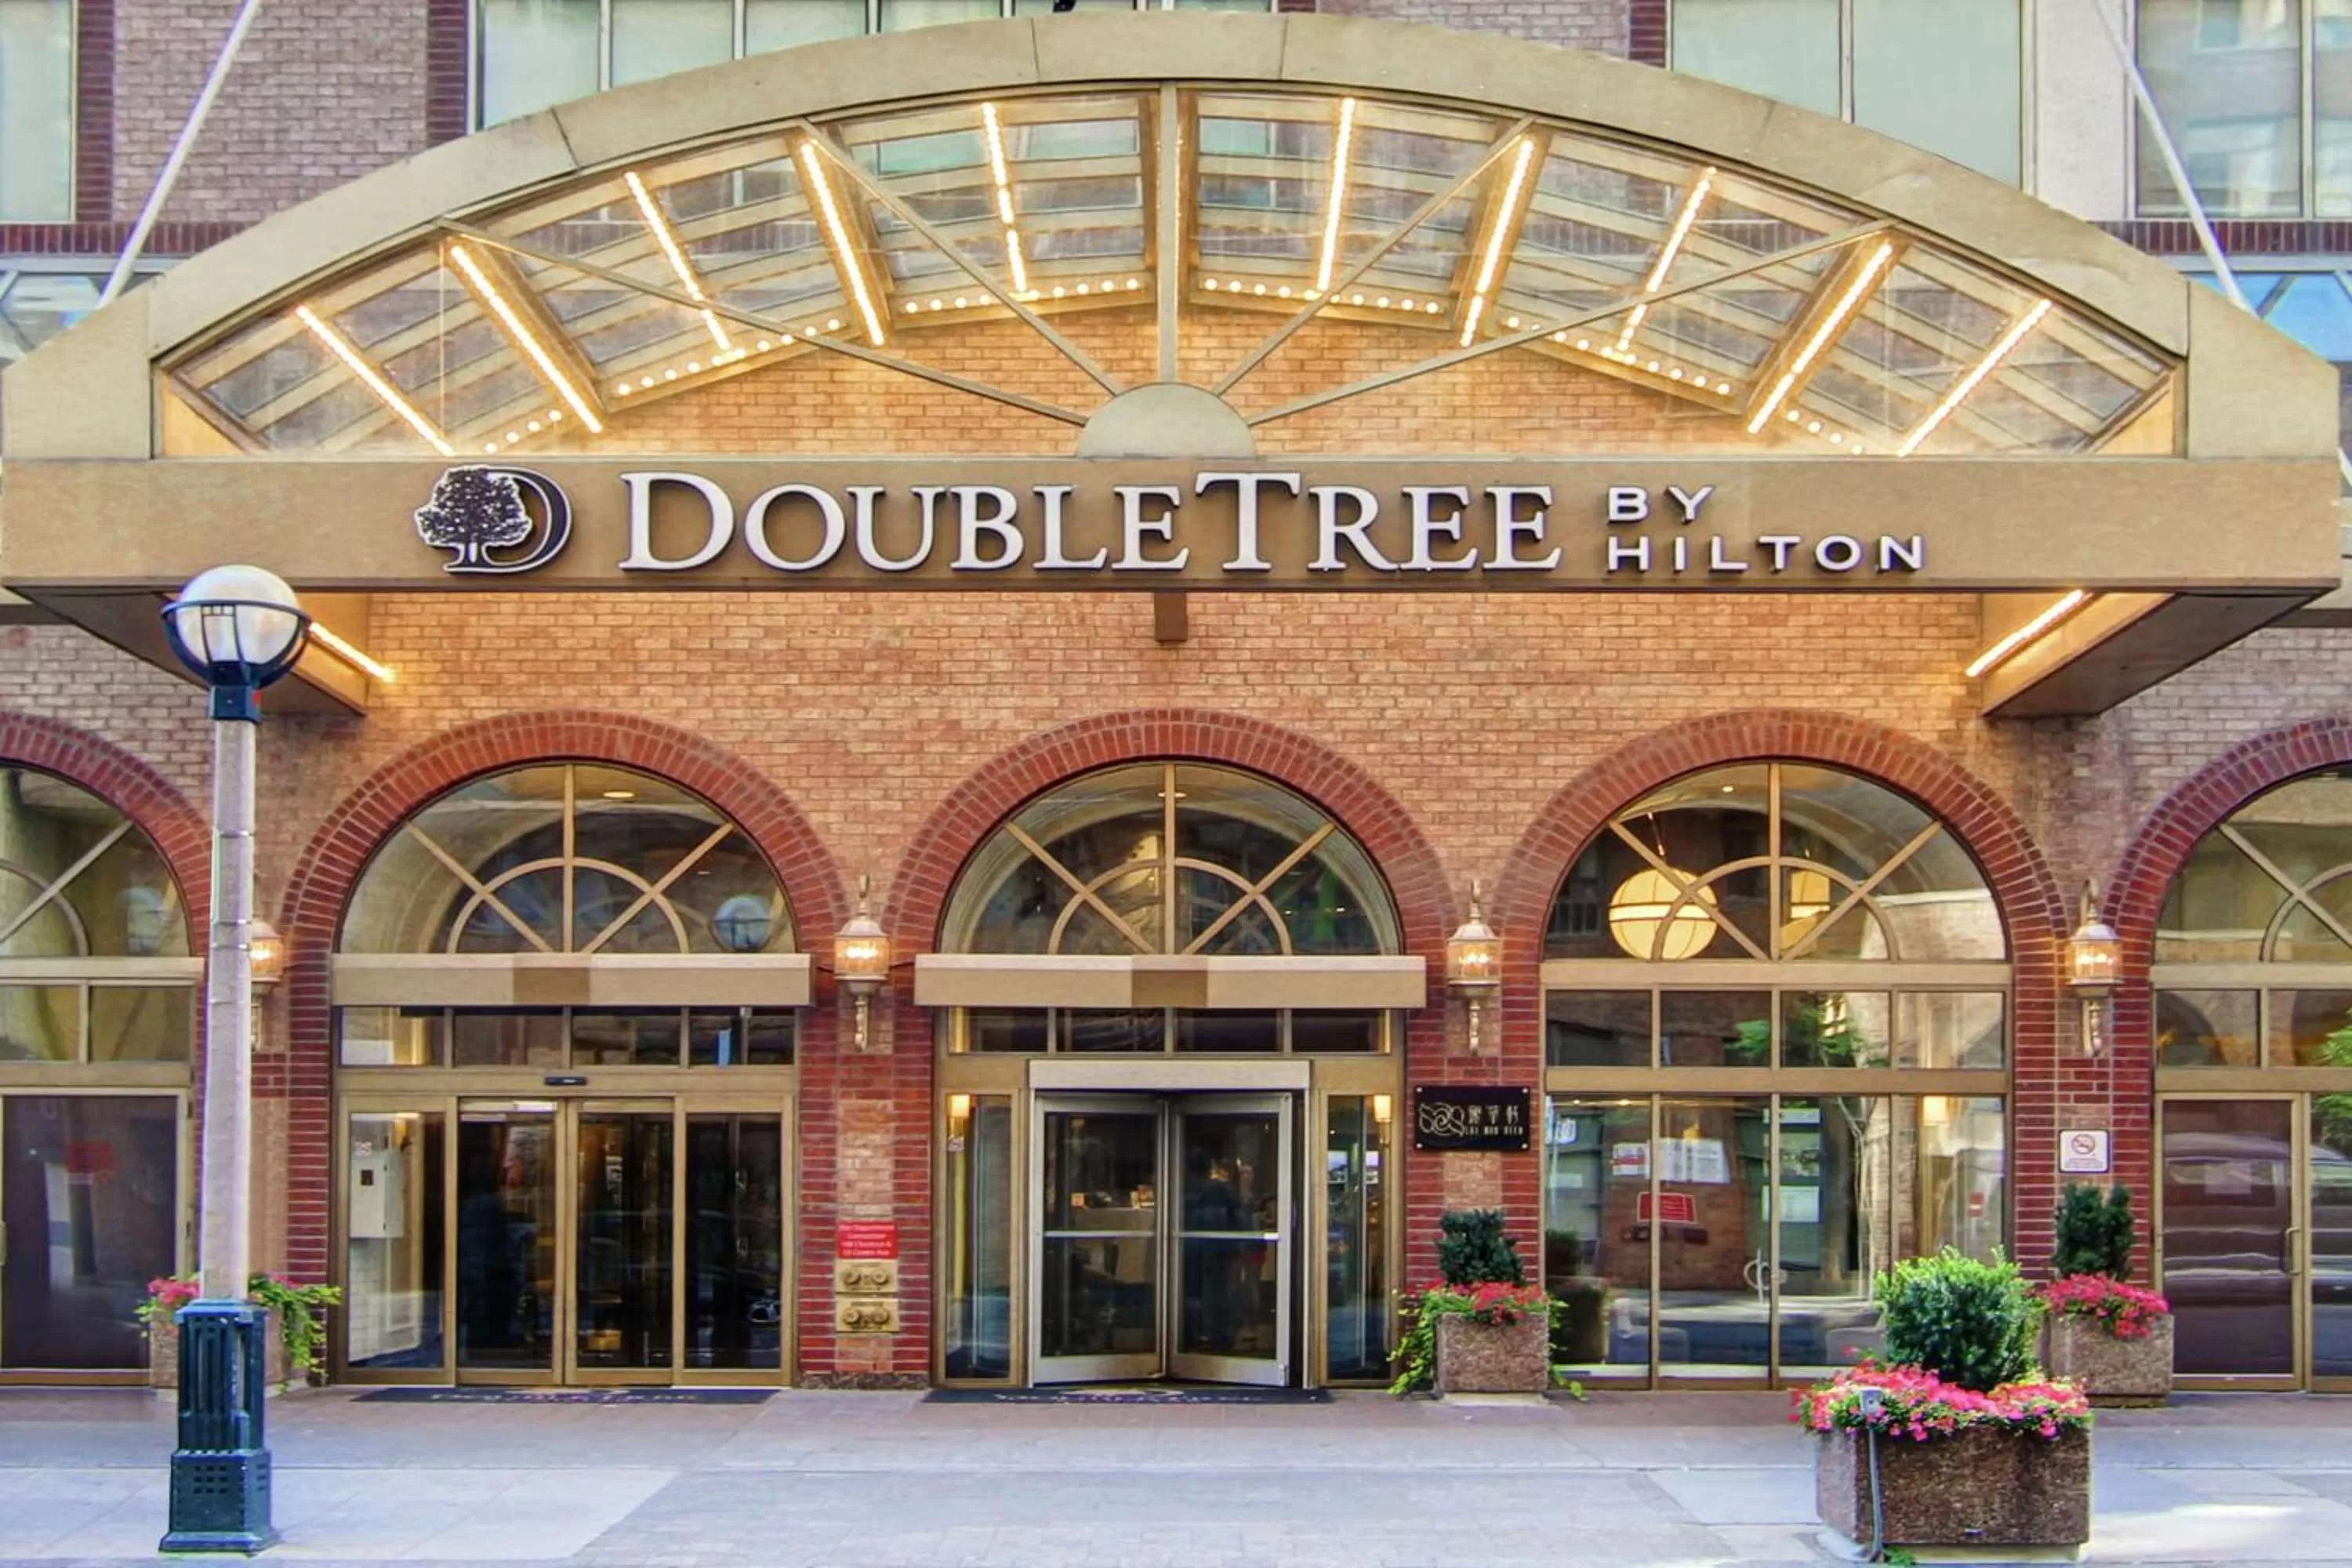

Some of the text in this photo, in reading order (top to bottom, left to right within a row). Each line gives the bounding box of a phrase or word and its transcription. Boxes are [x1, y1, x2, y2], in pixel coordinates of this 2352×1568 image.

[618, 470, 1563, 572] DOUBLETREE
[1607, 486, 1714, 524] BY
[1607, 535, 1923, 573] HILTON
